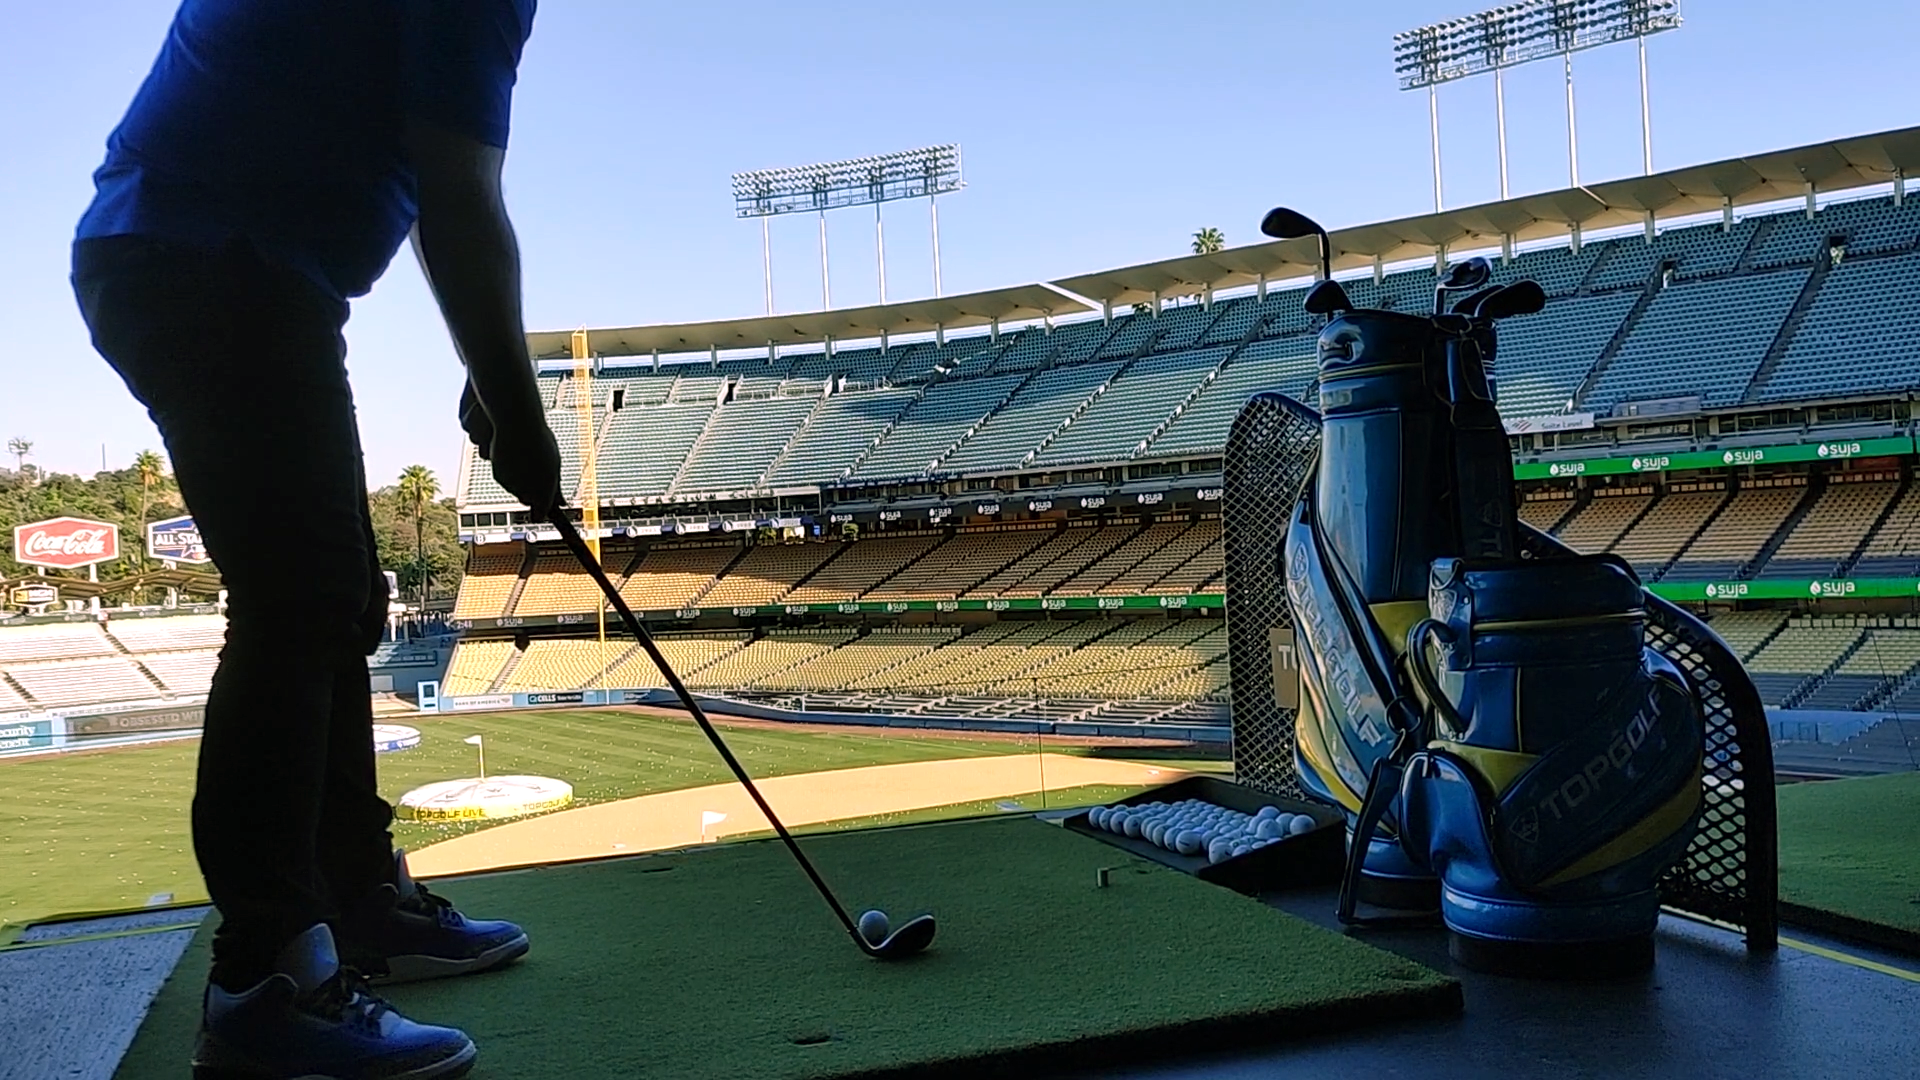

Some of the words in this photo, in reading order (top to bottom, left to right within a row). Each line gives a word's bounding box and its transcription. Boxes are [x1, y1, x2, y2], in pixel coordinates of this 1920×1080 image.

[1829, 442, 1861, 457] suja
[1734, 450, 1764, 464] suja
[1559, 461, 1585, 476] suja
[1643, 456, 1670, 471] suja
[1144, 493, 1163, 504] suja
[1204, 489, 1223, 500] suja
[1035, 500, 1052, 511] suja
[1087, 497, 1105, 508] suja
[983, 504, 1000, 515] suja
[836, 514, 853, 523] suja
[886, 511, 901, 520] suja
[25, 529, 109, 557] Coca-Cola
[154, 532, 204, 546] ALL-STA
[1717, 583, 1748, 598] suja
[1823, 581, 1856, 597] suja
[892, 603, 908, 613] suja
[942, 602, 959, 612] suja
[993, 600, 1010, 611] suja
[1049, 599, 1066, 610] suja
[1105, 598, 1124, 609] suja
[1167, 597, 1187, 608] suja
[739, 608, 756, 617] suja
[792, 605, 808, 615] suja
[844, 603, 860, 614] suja
[565, 615, 584, 624] suja
[683, 610, 700, 619] suja
[504, 618, 523, 627] suja
[538, 694, 556, 703] CELLS
[119, 713, 179, 727] OBSESSED
[181, 710, 204, 722] WIT
[0, 725, 36, 738] ecurity
[1540, 684, 1662, 820] TOPGOLF
[416, 809, 461, 820] TOPGOLF
[463, 808, 485, 819] LIVE
